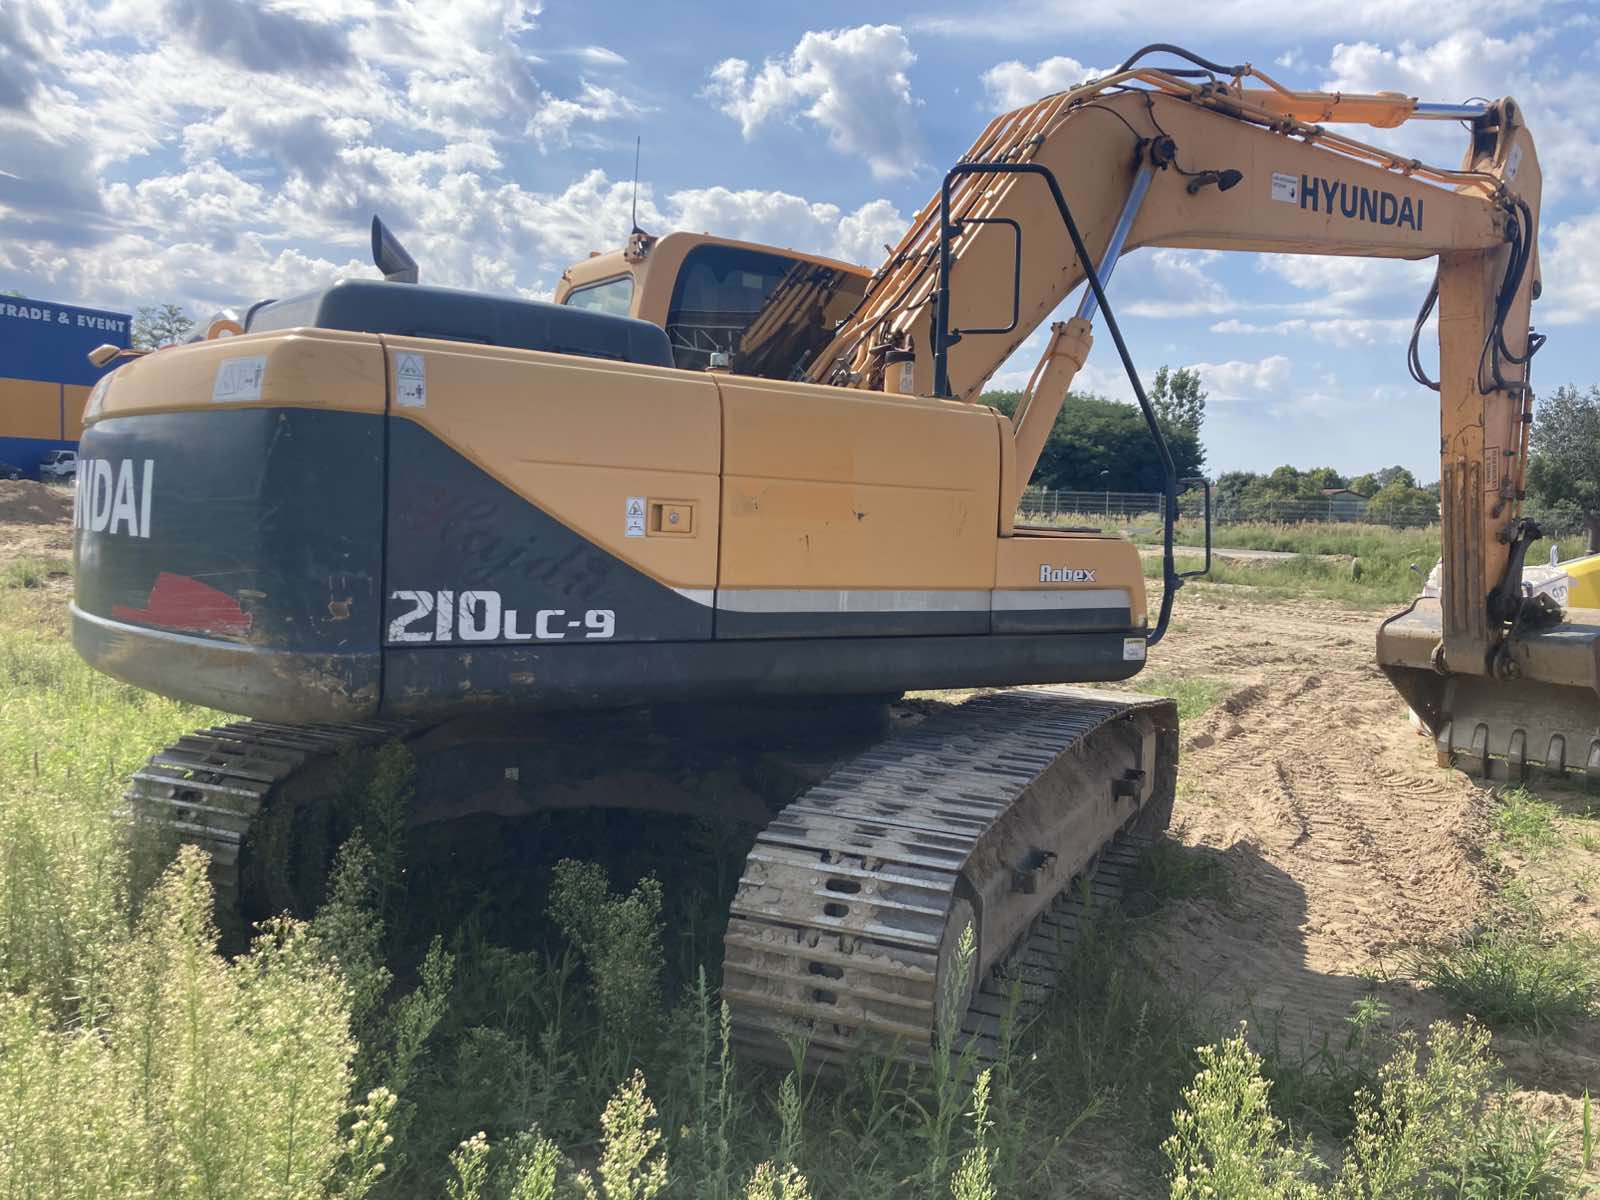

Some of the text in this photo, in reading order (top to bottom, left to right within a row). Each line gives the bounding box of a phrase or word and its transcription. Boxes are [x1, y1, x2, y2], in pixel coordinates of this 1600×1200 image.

[1301, 174, 1424, 232] HYUNDAI
[0, 302, 125, 333] TRADE & EVENT
[73, 458, 154, 539] NDAI
[1039, 564, 1096, 583] Robex
